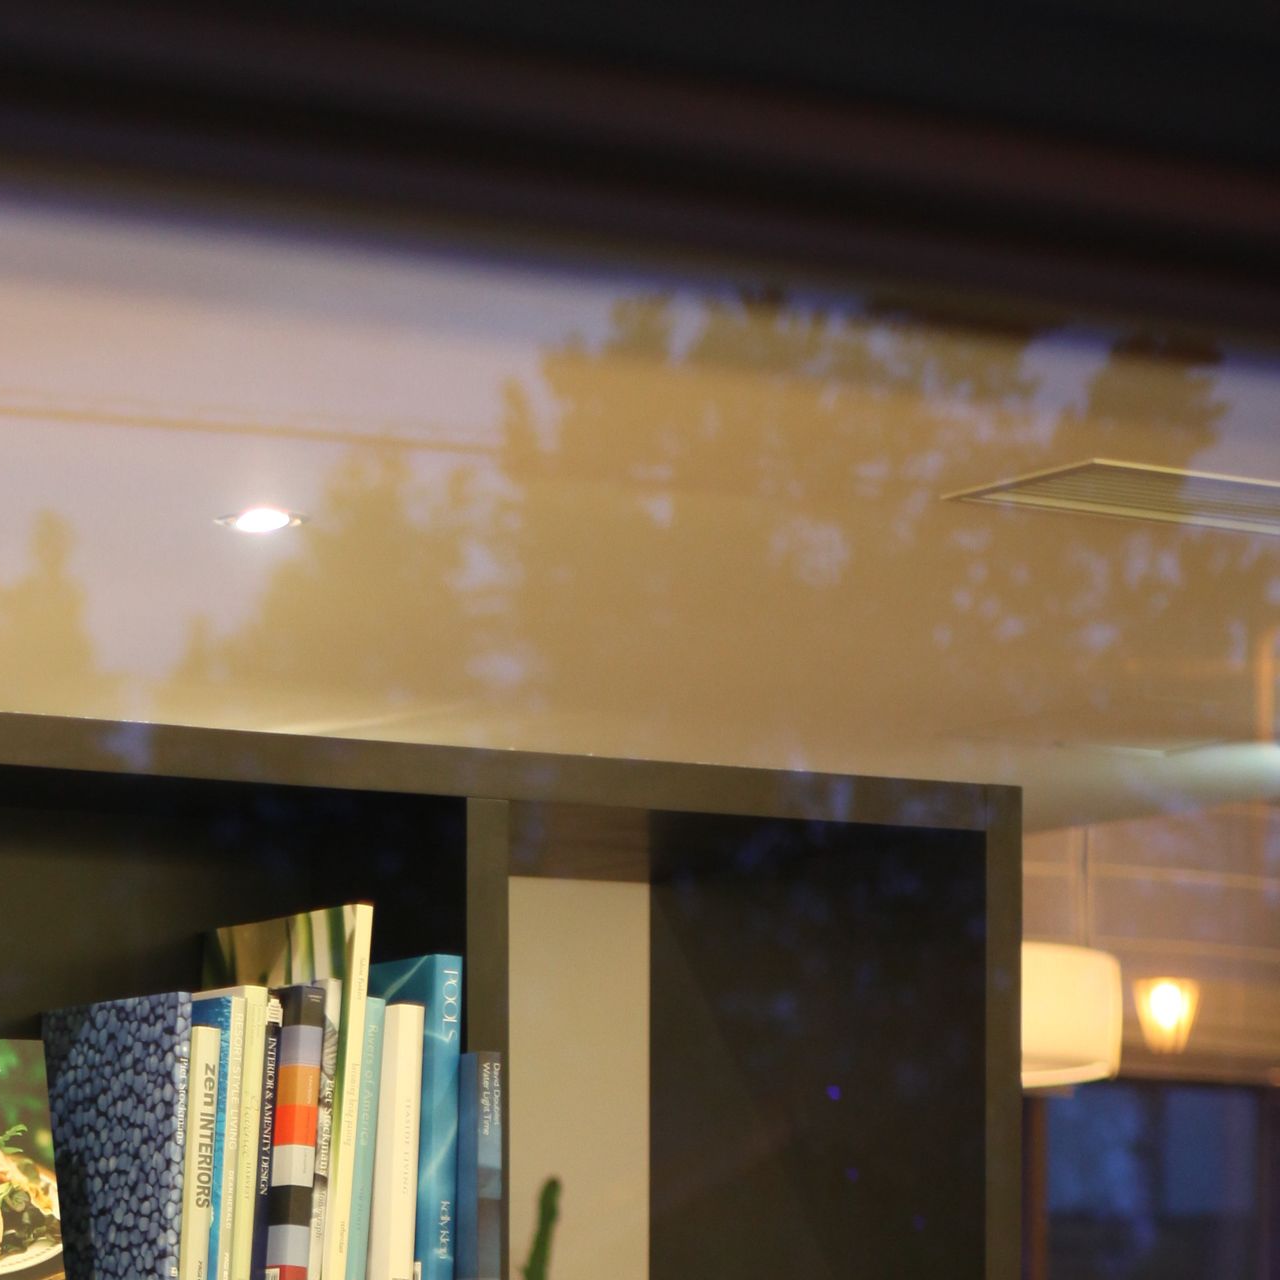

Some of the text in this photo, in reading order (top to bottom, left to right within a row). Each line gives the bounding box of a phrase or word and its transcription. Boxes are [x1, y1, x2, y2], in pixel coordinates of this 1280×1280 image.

[441, 969, 459, 1042] POOLS
[265, 1036, 277, 1089] INTERIOR
[365, 1023, 379, 1066] Rivers
[175, 1057, 190, 1145] Piet Stockmans
[228, 1012, 245, 1151] RESORT STYLE LIVING
[480, 1062, 492, 1136] Water Light Time
[492, 1063, 502, 1086] David
[195, 1062, 217, 1208] zen INTERIORS
[261, 1101, 274, 1153] AMENITY
[318, 1079, 336, 1176] Piet Stockmans
[359, 1089, 375, 1147] America
[259, 1155, 271, 1195] DESIGN
[402, 1152, 411, 1195] LIVING
